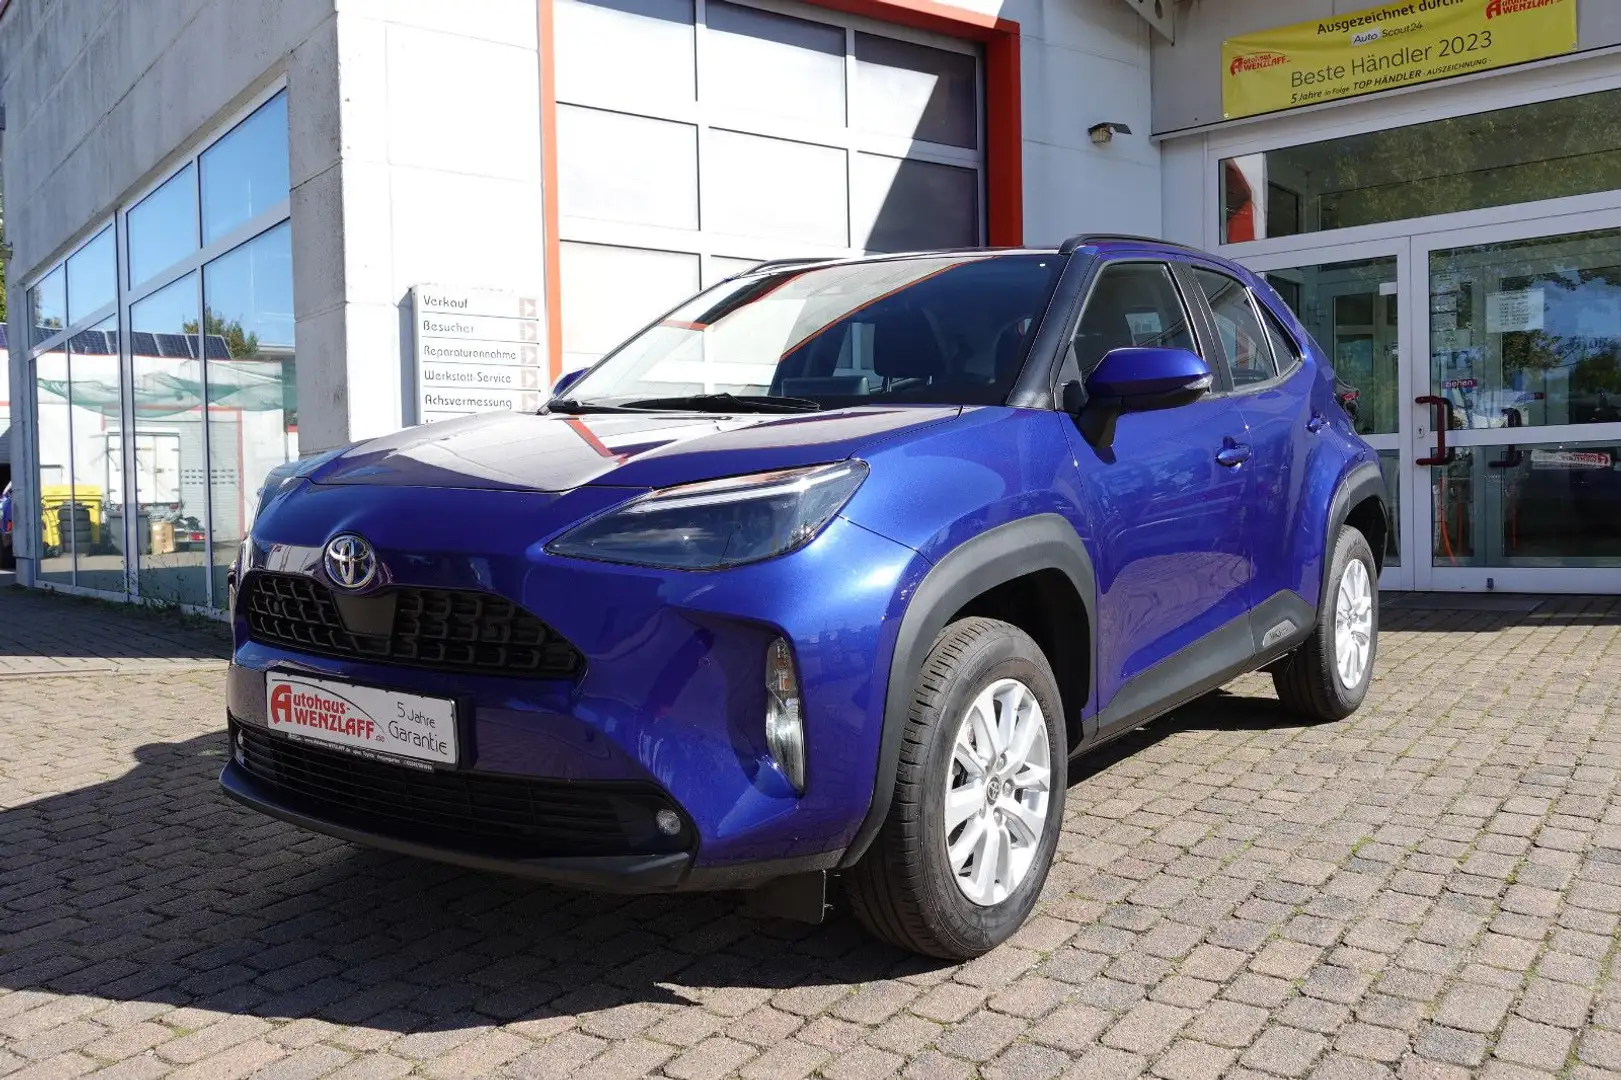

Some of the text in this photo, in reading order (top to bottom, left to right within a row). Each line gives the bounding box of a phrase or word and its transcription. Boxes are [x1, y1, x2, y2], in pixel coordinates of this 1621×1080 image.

[1317, 5, 1415, 34] Ausgezeichnet
[1381, 22, 1423, 38] Scout24
[1291, 30, 1492, 88] Beste Händler 2023
[1290, 93, 1298, 104] 5
[1298, 91, 1322, 101] Jahre
[1353, 80, 1372, 90] TOP
[1374, 69, 1422, 86] HÄNDLER
[423, 295, 468, 308] Verkauf
[423, 320, 475, 333] Besucher
[423, 345, 517, 360] Reparaturannahme
[425, 394, 512, 409] Achsvermessung
[397, 701, 436, 729] 5 Jahre
[388, 720, 447, 756] Garantie
